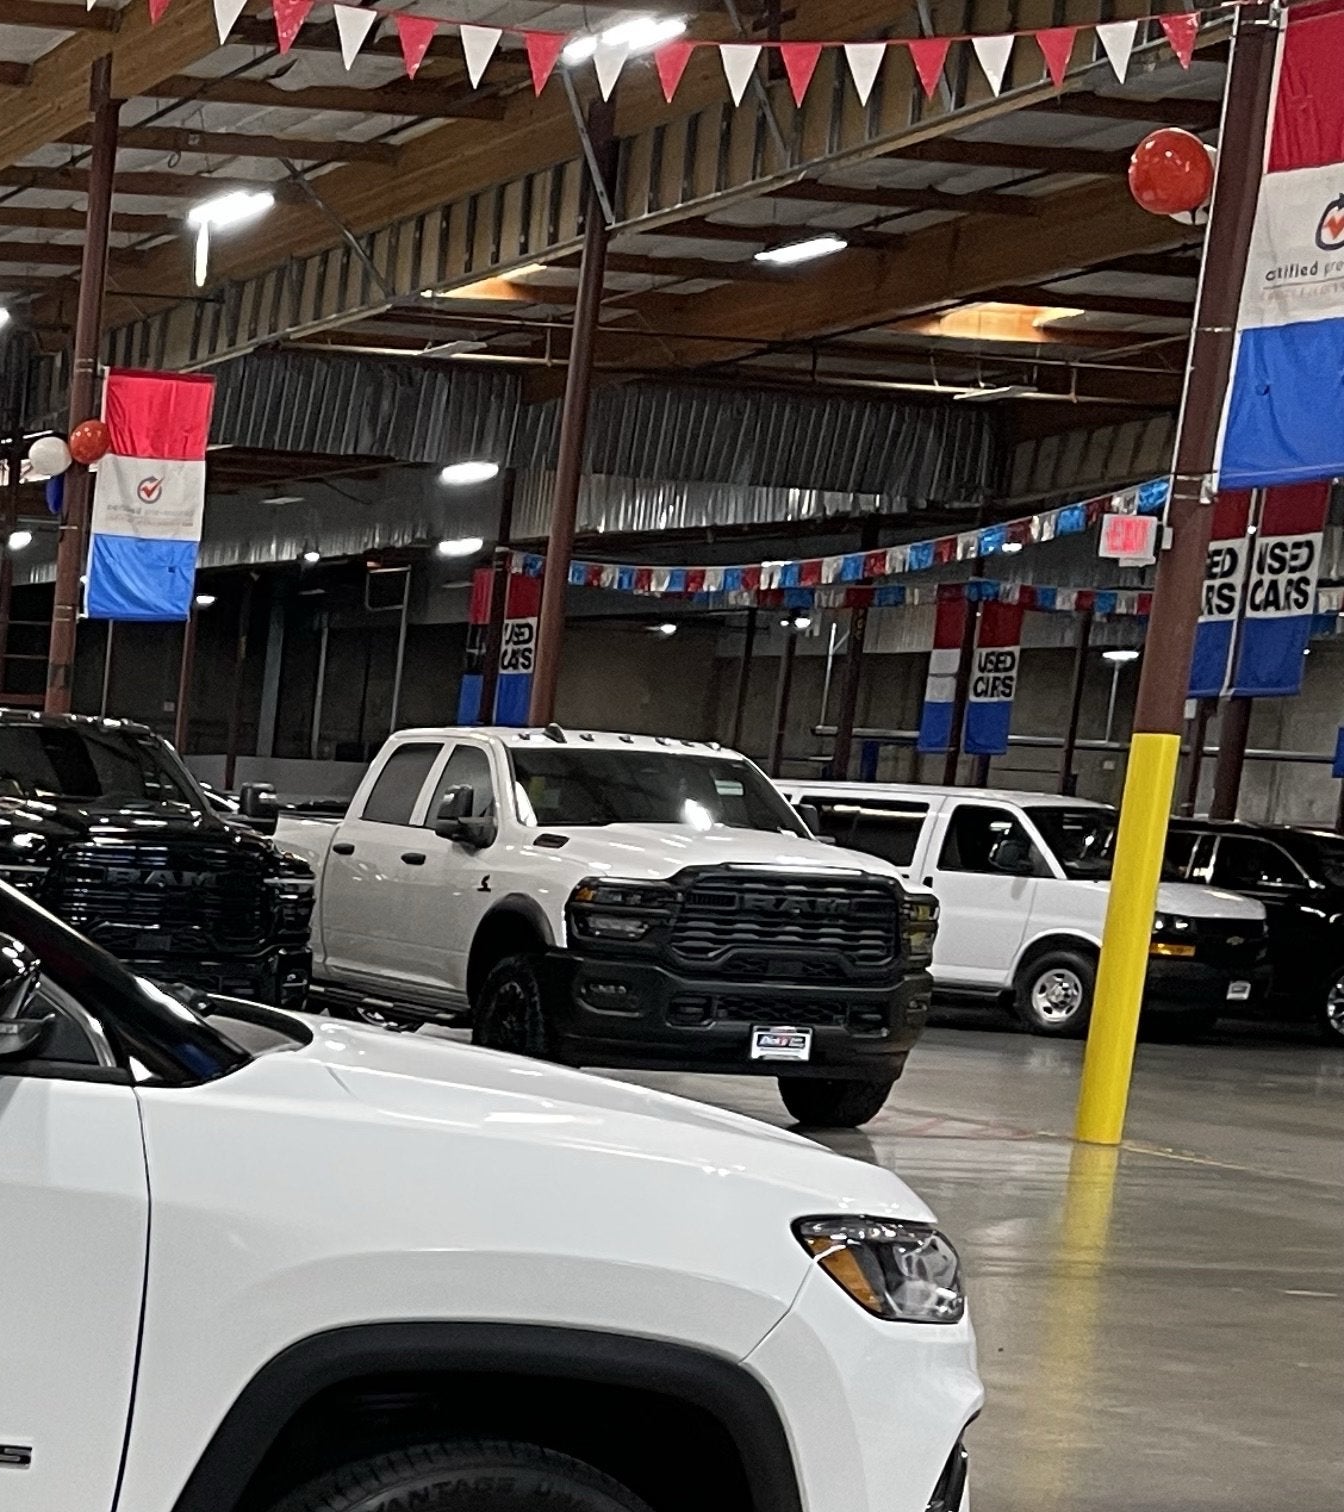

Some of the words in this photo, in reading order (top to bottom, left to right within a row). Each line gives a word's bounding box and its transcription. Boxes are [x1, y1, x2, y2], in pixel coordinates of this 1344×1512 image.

[1207, 547, 1239, 578] ED
[1256, 540, 1315, 575] USED
[1203, 582, 1237, 615] RS
[504, 622, 534, 646] UED
[977, 650, 1016, 673] USED
[108, 867, 217, 886] RAM
[743, 894, 850, 914] RAM
